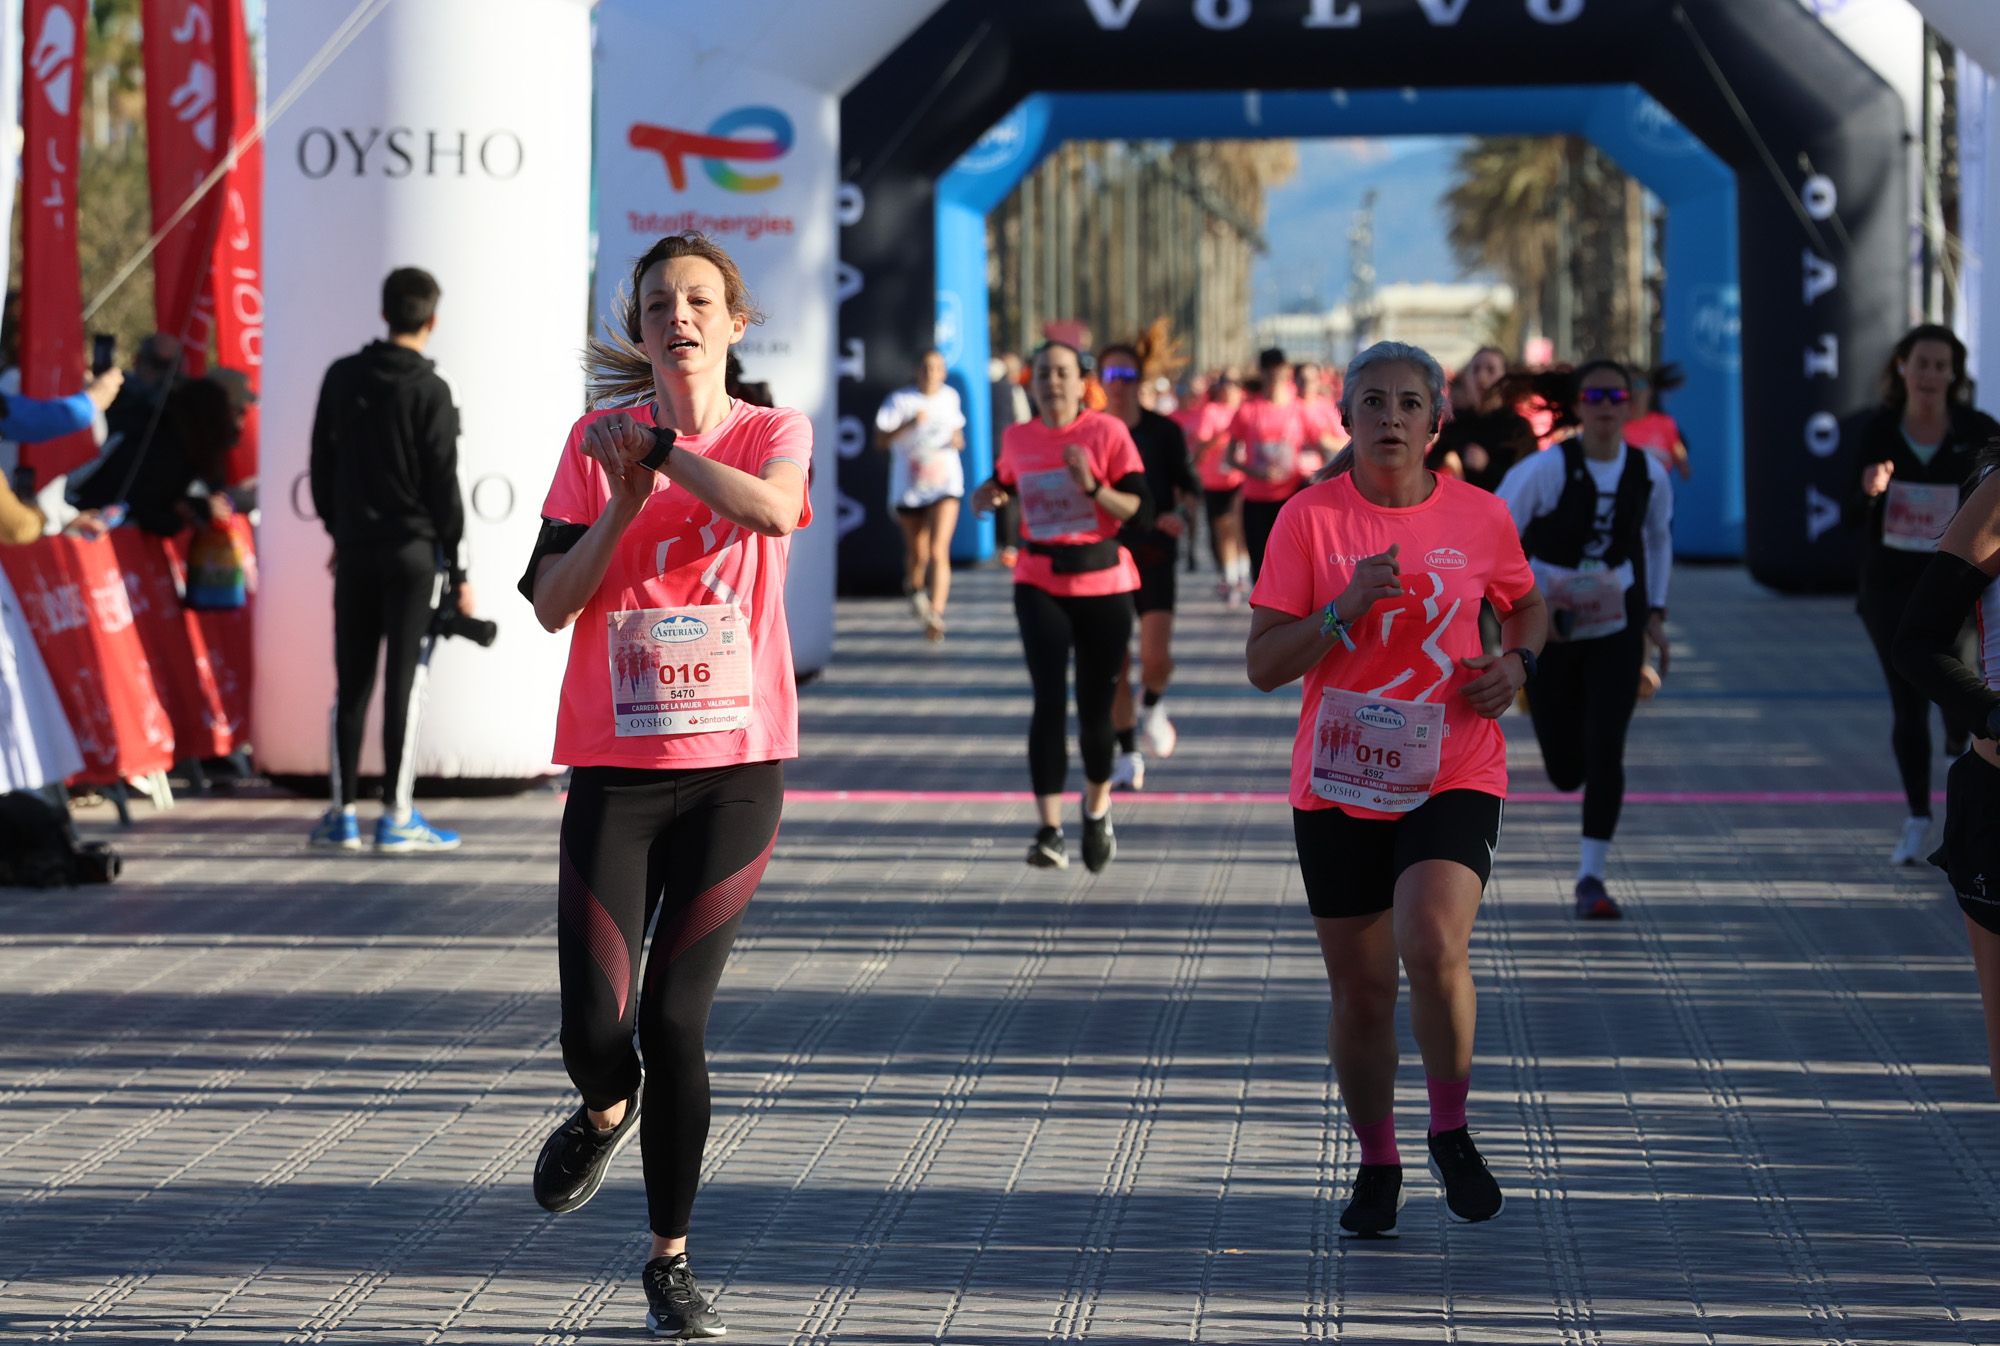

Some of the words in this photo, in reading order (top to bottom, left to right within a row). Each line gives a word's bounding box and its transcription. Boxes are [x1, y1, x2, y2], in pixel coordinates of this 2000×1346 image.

[1084, 0, 1586, 30] VOLVO
[297, 126, 523, 180] OYSHO
[1803, 174, 1841, 542] VOLVO
[654, 626, 704, 638] ASTURIANA
[659, 662, 711, 685] 016
[670, 689, 695, 699] 5470
[631, 703, 659, 712] CARRERA
[661, 703, 669, 711] DE
[670, 702, 678, 710] LA
[680, 701, 702, 709] MUJER
[707, 699, 736, 707] VALENCIA
[630, 717, 672, 729] OYSHO
[699, 715, 738, 724] Santander
[1358, 711, 1402, 727] ASTURIANA
[1356, 745, 1402, 768] 016
[1327, 772, 1352, 783] CARRERA
[1353, 776, 1360, 784] DE
[1369, 780, 1388, 790] MUJER
[1362, 768, 1384, 779] 4592
[1323, 783, 1361, 799] OYSHO
[1382, 797, 1417, 806] Santander
